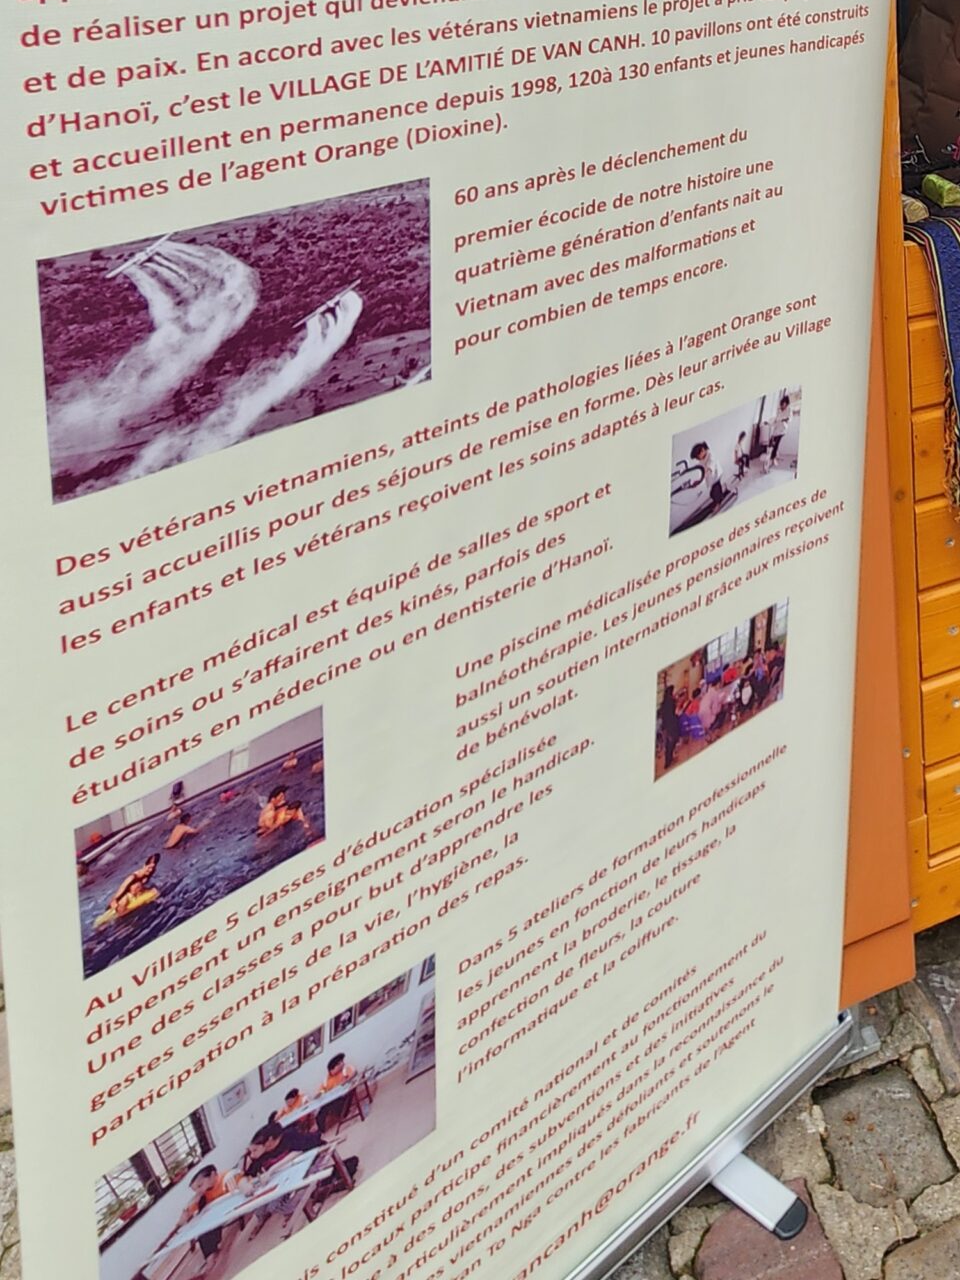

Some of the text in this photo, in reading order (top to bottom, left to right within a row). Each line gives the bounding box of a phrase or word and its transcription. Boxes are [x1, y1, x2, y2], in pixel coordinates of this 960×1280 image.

[26, 4, 869, 138] d’Hanoï, c’est le VILLAGE DE L’AMITIÉ DE VAN CANH. 10 pavillons ont été construits
[40, 113, 508, 216] victimes de l’agent Orange (Dioxine).
[454, 128, 747, 206] 60 ans après le déclenchement du
[455, 259, 727, 356] pour combien de temps encore.
[56, 294, 816, 577] Des vétérans vietnamiens, atteints de pathologies liées à l’agent Orange sont
[60, 381, 724, 655] les enfants et les vétérans reçoivent les soins adaptés à leur cas.
[65, 483, 611, 733] Le centre médical est équipé de salles de sport et
[71, 537, 613, 805] étudiants en médecine ou en dentisterie d’Hanoï.
[456, 489, 827, 679] Une piscine médicalisée propose des séances de
[456, 688, 578, 761] de bénévolat.
[85, 735, 557, 1018] Au Village 5 classes d’éducation spécialisée
[458, 745, 787, 975] Dans 5 ateliers de formation professionnelle
[583, 972, 599, 989] et
[603, 960, 615, 976] la
[91, 856, 528, 1147] participation à la préparation des repas.
[326, 1184, 418, 1264] constitué
[470, 1096, 529, 1150] comité
[534, 1041, 598, 1101] national
[602, 1028, 618, 1046] et
[622, 1012, 639, 1031] de
[643, 966, 696, 1013] comités
